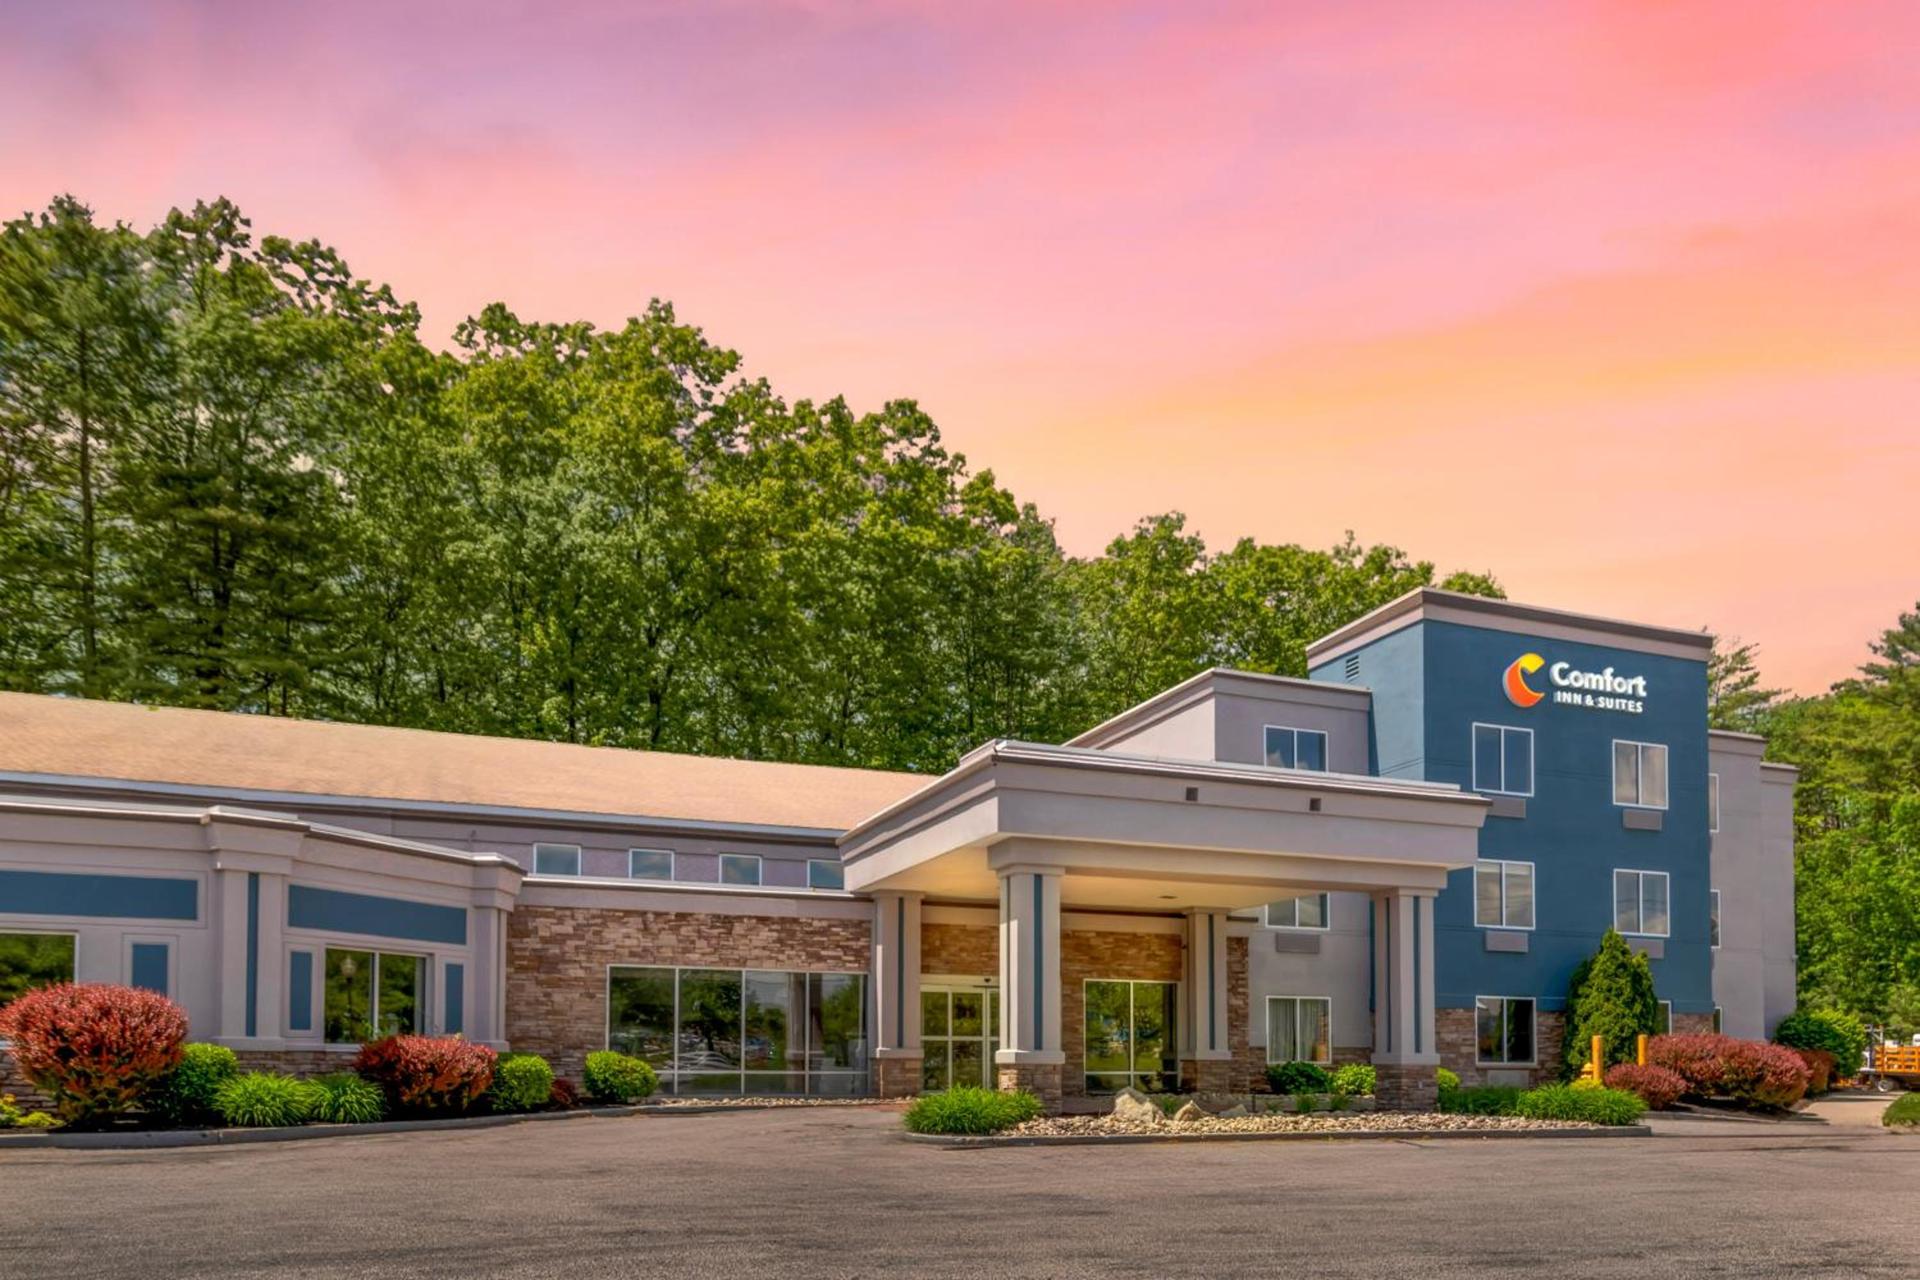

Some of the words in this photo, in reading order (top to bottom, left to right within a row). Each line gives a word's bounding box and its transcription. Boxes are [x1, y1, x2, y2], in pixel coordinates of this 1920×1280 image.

[1550, 661, 1647, 697] Comfort
[1554, 690, 1582, 706] INN
[1584, 693, 1595, 707] &
[1598, 696, 1643, 713] SUITES
